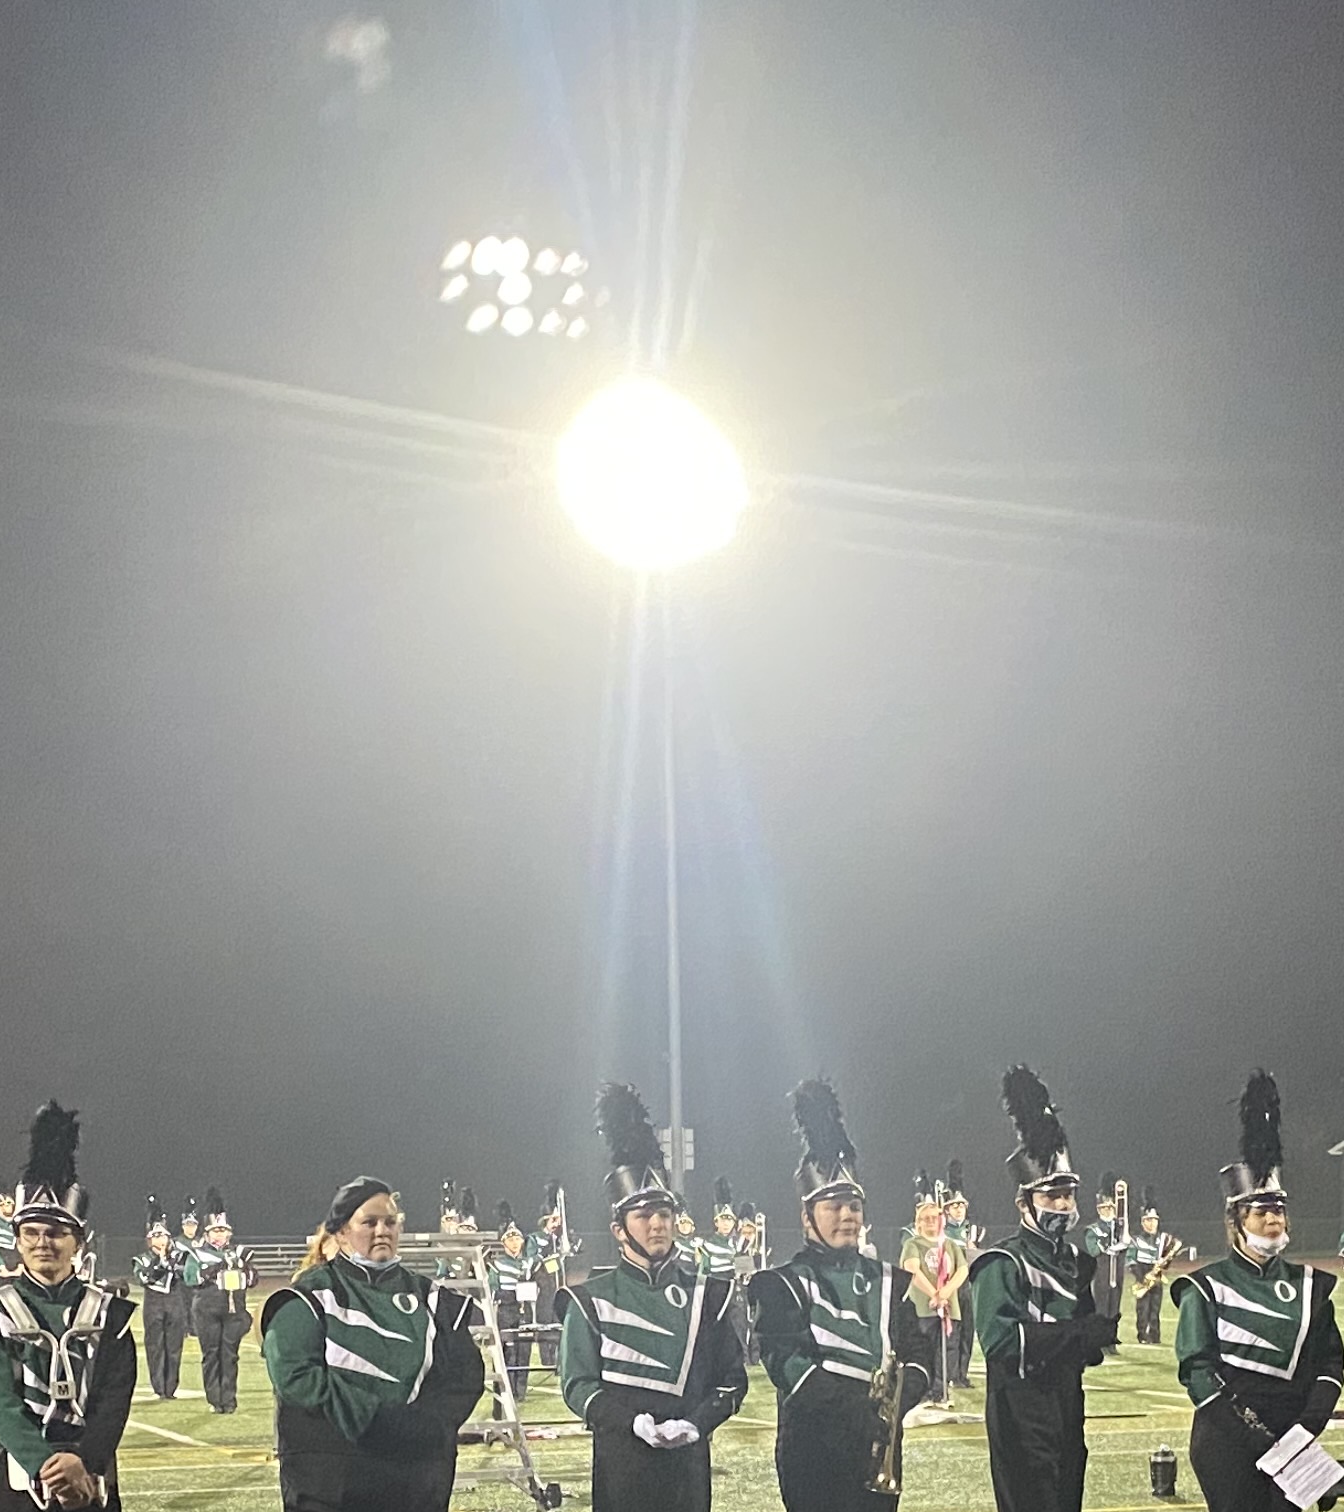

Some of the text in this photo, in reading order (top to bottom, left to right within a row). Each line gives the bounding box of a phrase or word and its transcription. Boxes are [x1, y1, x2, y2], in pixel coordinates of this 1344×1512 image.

[664, 1284, 688, 1309] O
[1274, 1280, 1297, 1302] O
[392, 1292, 419, 1315] O
